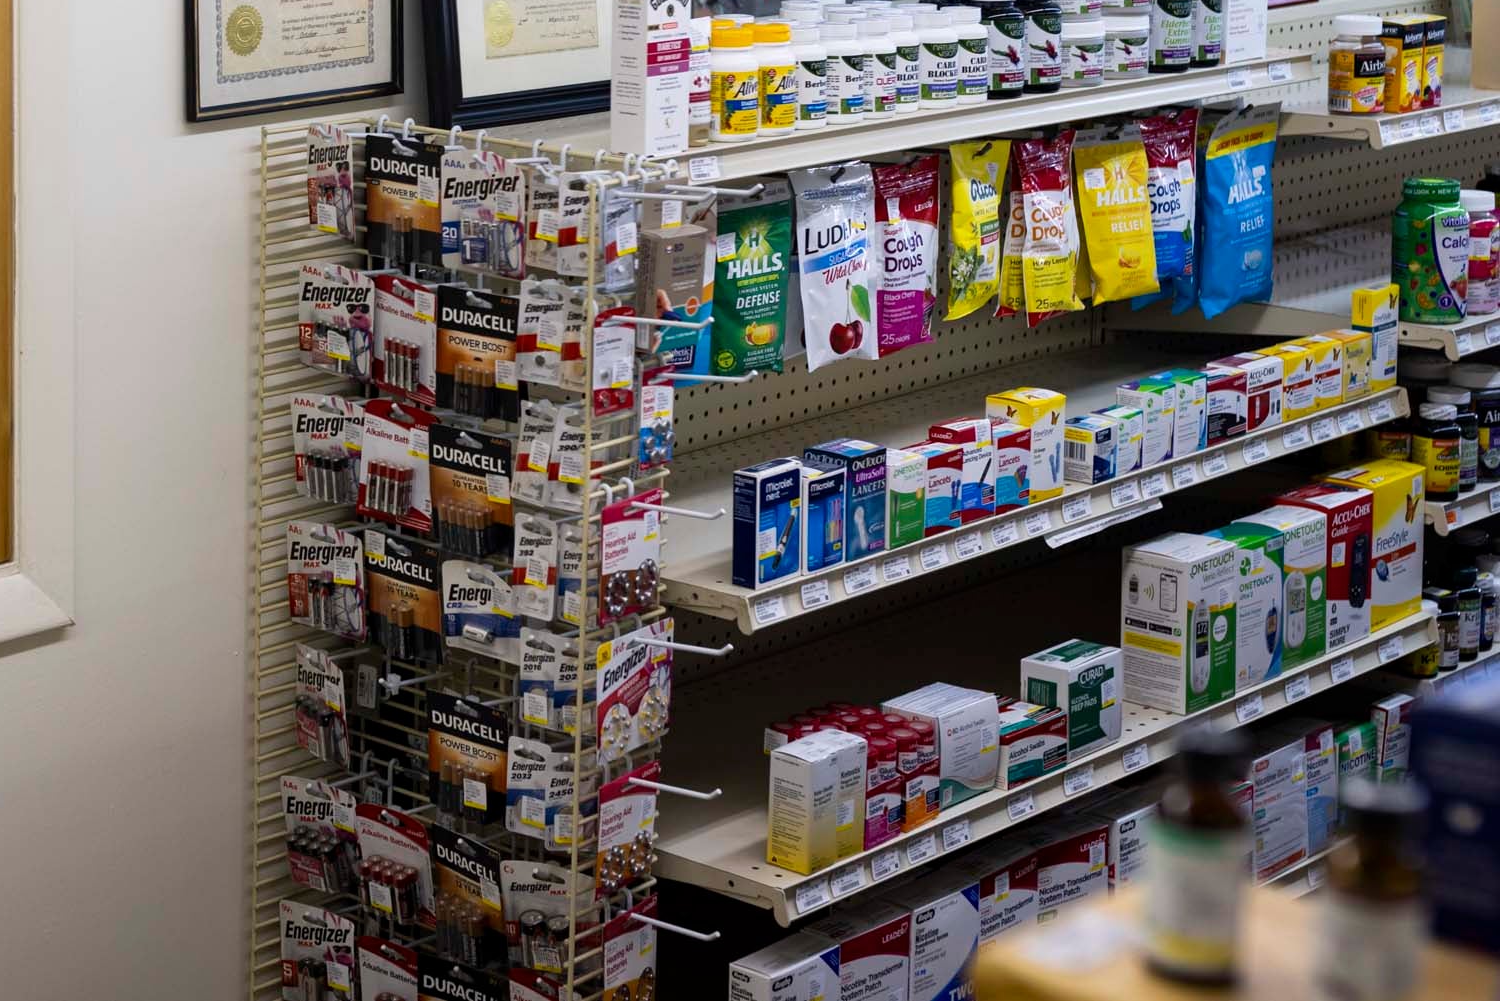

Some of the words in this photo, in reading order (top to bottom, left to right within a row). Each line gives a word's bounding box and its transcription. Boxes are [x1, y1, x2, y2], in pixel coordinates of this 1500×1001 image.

[1359, 59, 1385, 73] Airbo
[308, 143, 350, 168] Energizer
[370, 156, 440, 180] DURACELL
[382, 185, 407, 198] POWER
[443, 175, 520, 201] Energizer
[1096, 185, 1147, 208] HALLS
[441, 226, 458, 239] 20
[1110, 219, 1144, 233] RELIEF
[1240, 215, 1265, 233] RELIEF
[462, 240, 471, 259] 1
[884, 253, 923, 273] Drops
[301, 281, 371, 307] Energizer
[760, 283, 779, 292] SYSTEM
[314, 302, 332, 310] MAX
[524, 302, 564, 314] Energizer
[735, 290, 781, 310] DEFENSE
[1035, 299, 1049, 310] 25
[376, 302, 398, 317] Alkaline
[441, 306, 515, 334] DURACELL
[300, 325, 311, 338] 12
[881, 333, 895, 345] 25
[448, 335, 480, 349] POWER
[481, 341, 508, 353] BOOST
[1248, 366, 1277, 382] ACCU-CHEK
[310, 432, 328, 440] MAX
[366, 427, 392, 440] Alkaline
[432, 444, 506, 474] DURACELL
[999, 454, 1021, 469] Lancets
[855, 466, 885, 483] UltraSoft
[928, 475, 952, 489] Lancets
[452, 479, 461, 489] 10
[765, 477, 794, 494] Microlet
[810, 479, 836, 493] Microlet
[851, 480, 886, 498] LANCETS
[1331, 503, 1372, 527] ACCU-CHEK
[605, 537, 626, 549] Hearing
[627, 531, 636, 541] Aid
[1331, 525, 1349, 538] Guide
[519, 536, 553, 548] Energizer
[1376, 528, 1409, 553] FreeStyle
[290, 541, 359, 565] Energizer
[604, 547, 629, 561] Batteries
[303, 560, 320, 569] MAX
[368, 555, 433, 583] DURACELL
[1190, 551, 1235, 578] ONETOUCH
[1239, 574, 1274, 592] ONETOUCH
[1329, 624, 1351, 640] SIMPLY
[1329, 637, 1346, 649] MORE
[523, 653, 556, 664] Energizer
[523, 664, 542, 672] 2016
[602, 644, 648, 692] Energizer
[1078, 665, 1105, 685] CURAD
[431, 709, 504, 745] DURACELL
[439, 736, 472, 754] POWER
[472, 745, 499, 762] BOOST
[1008, 744, 1029, 760] Alcohol
[1029, 738, 1046, 754] Swabs
[511, 761, 546, 772] Energizer
[1341, 750, 1376, 773] NICOTINE
[361, 827, 389, 843] Alkaline
[389, 834, 420, 853] Batteries
[436, 843, 497, 885] DURACELL
[510, 881, 552, 894] Energizer
[1038, 882, 1066, 897] Nicotine
[1066, 869, 1104, 888] Transdermal
[1038, 891, 1062, 906] System
[1063, 885, 1081, 899] Patch
[980, 912, 1002, 928] Nicotine
[980, 921, 1000, 937] System
[1000, 914, 1016, 928] Patch
[285, 920, 350, 946] Energizer
[915, 927, 939, 944] Nicotine
[362, 961, 388, 977] Alkaline
[840, 975, 867, 995] Nicotine
[867, 960, 904, 982] Transdermal
[862, 980, 882, 995] Patch
